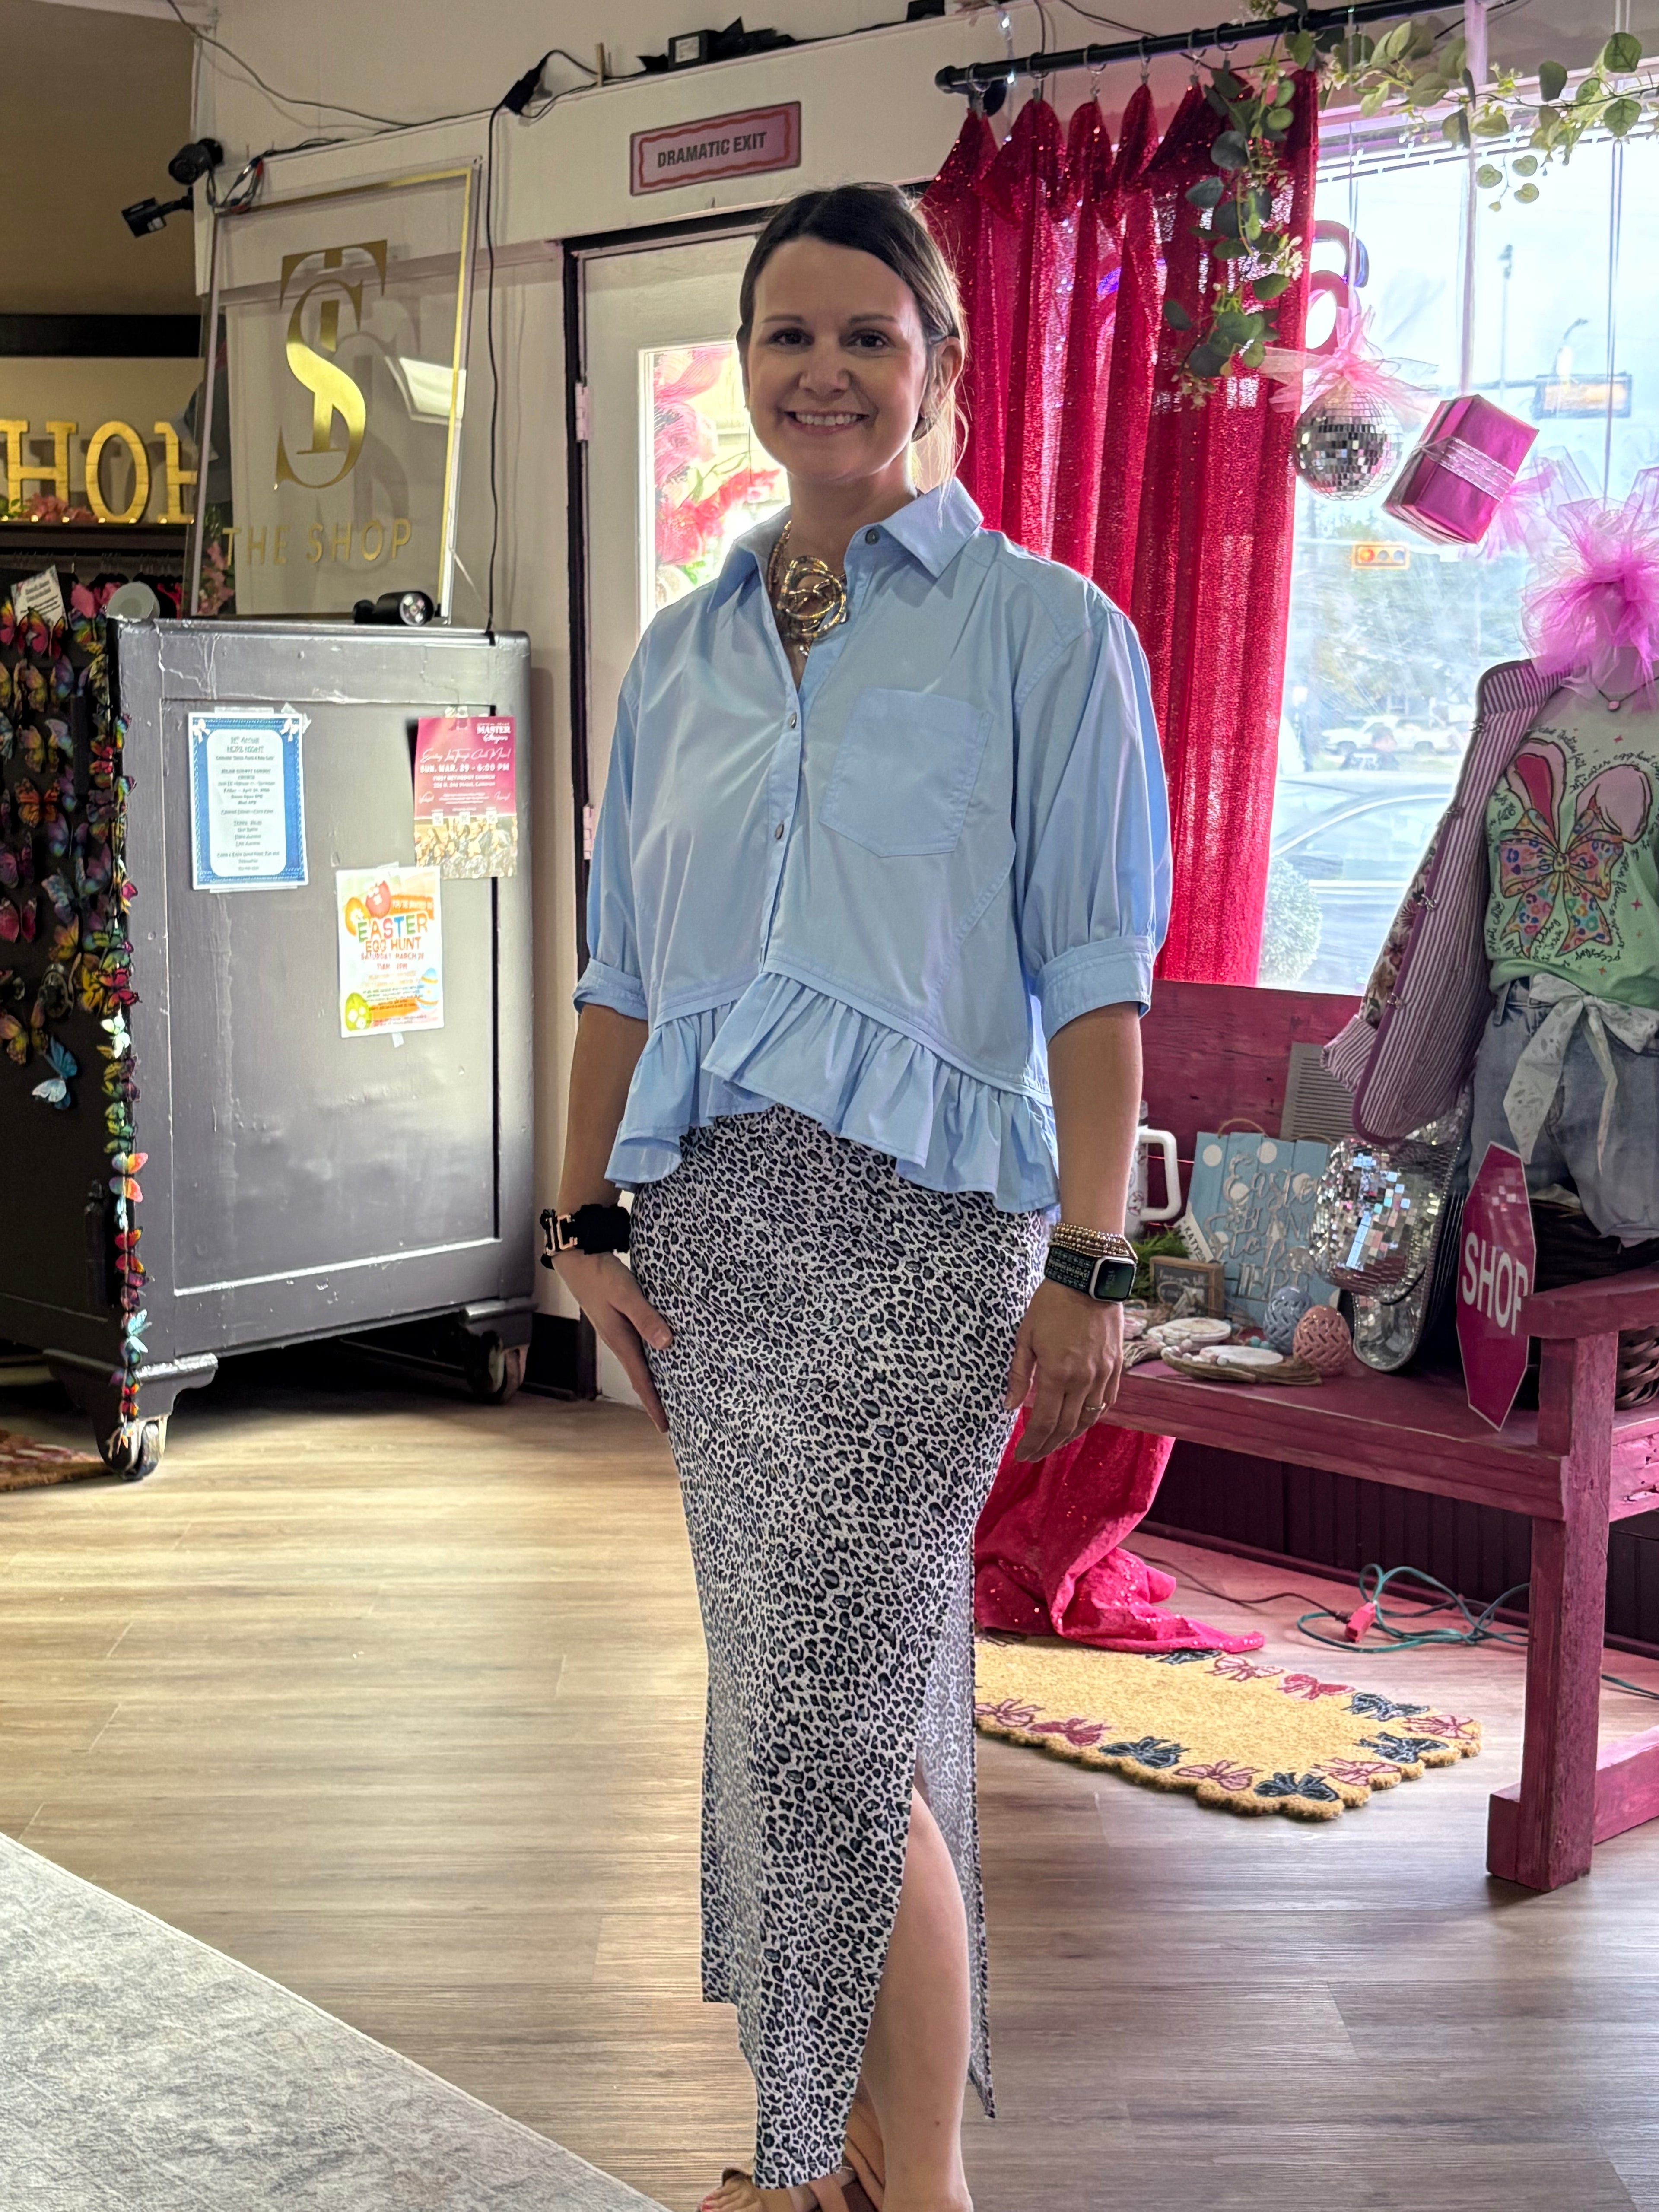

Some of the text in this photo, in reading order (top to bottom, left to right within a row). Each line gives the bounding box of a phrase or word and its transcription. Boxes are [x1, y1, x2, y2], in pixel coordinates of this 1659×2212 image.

[658, 132, 767, 168] DRAMATIC EXIT
[222, 518, 412, 566] THE SHOP
[477, 725, 511, 734] MASTER
[420, 765, 437, 773] SUN.
[439, 764, 458, 772] MAR.
[460, 763, 470, 772] 29
[497, 763, 510, 771] PM
[358, 913, 428, 943] EASTER
[365, 936, 422, 953] EGG HUNT
[1223, 1150, 1318, 1210] Easte
[1462, 1231, 1529, 1336] SHOP
